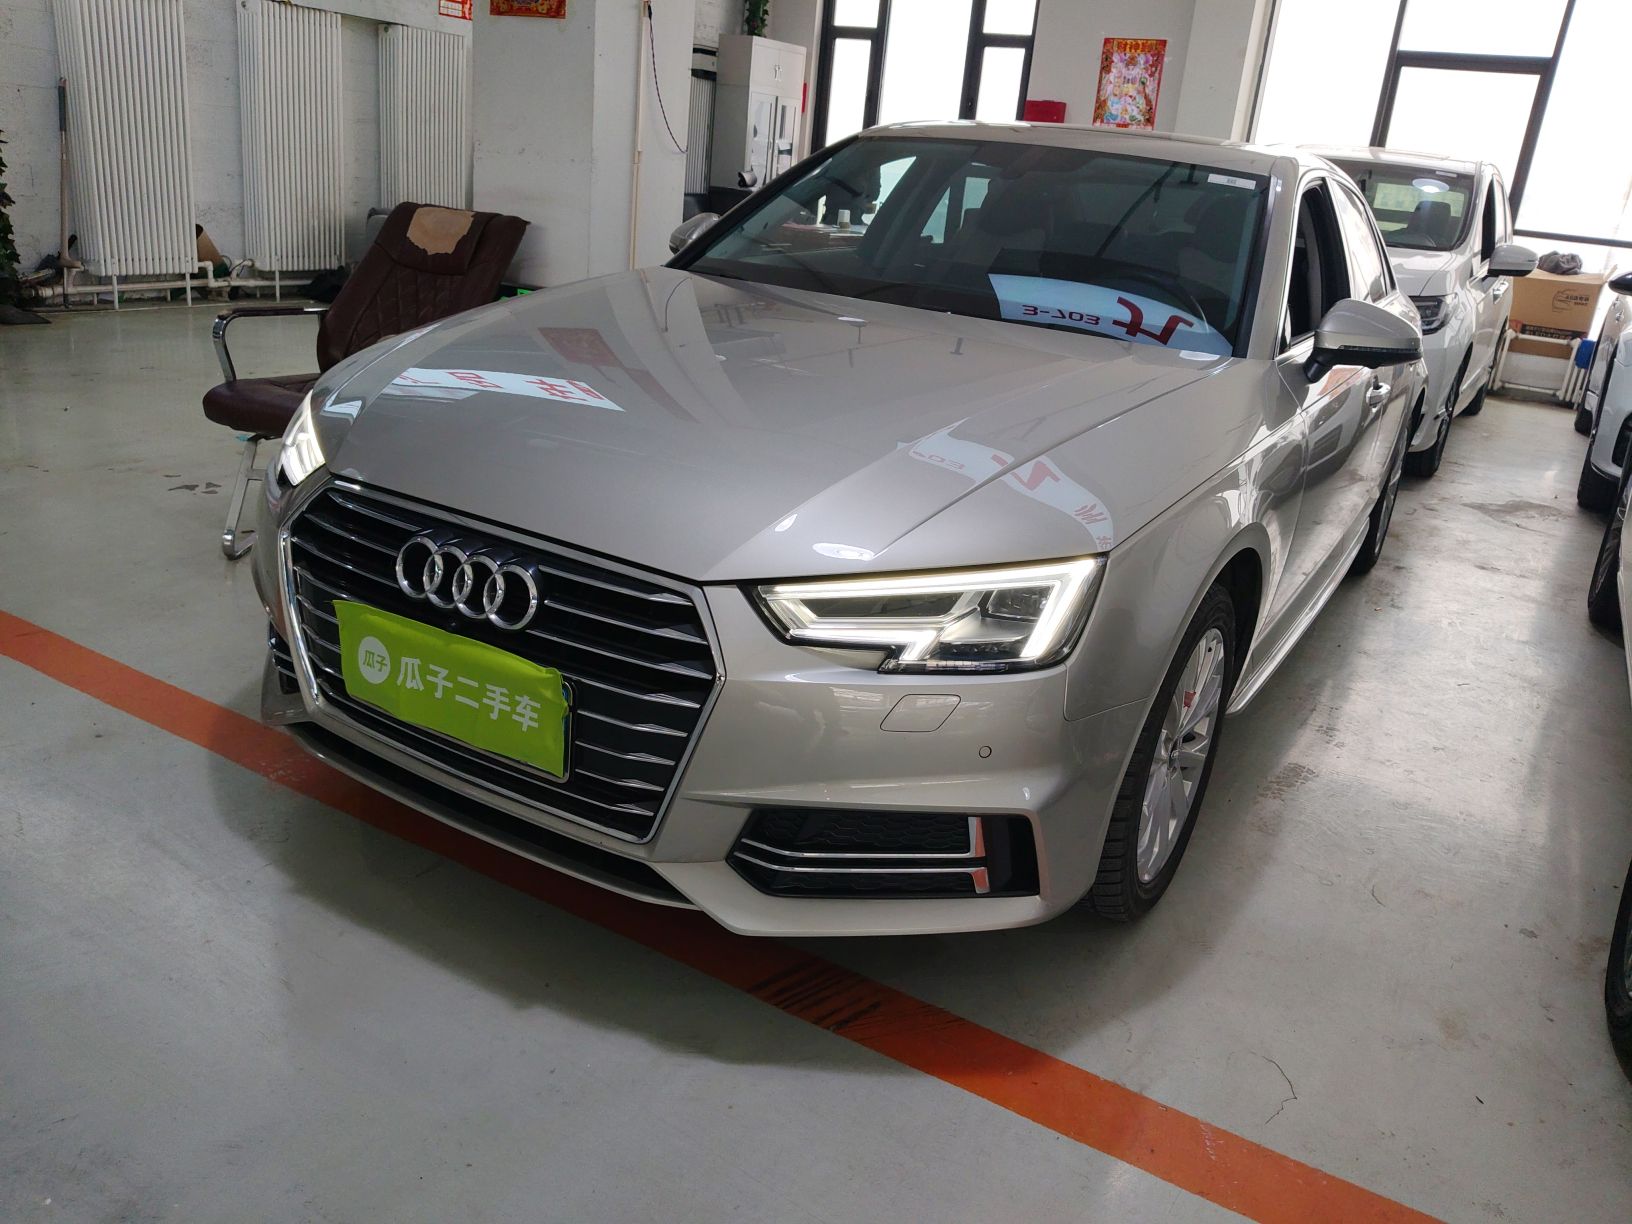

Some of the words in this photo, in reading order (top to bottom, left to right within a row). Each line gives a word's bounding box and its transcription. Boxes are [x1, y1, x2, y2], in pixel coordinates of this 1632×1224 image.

[362, 649, 388, 673] 瓜子
[396, 656, 542, 732] 瓜子二手车
